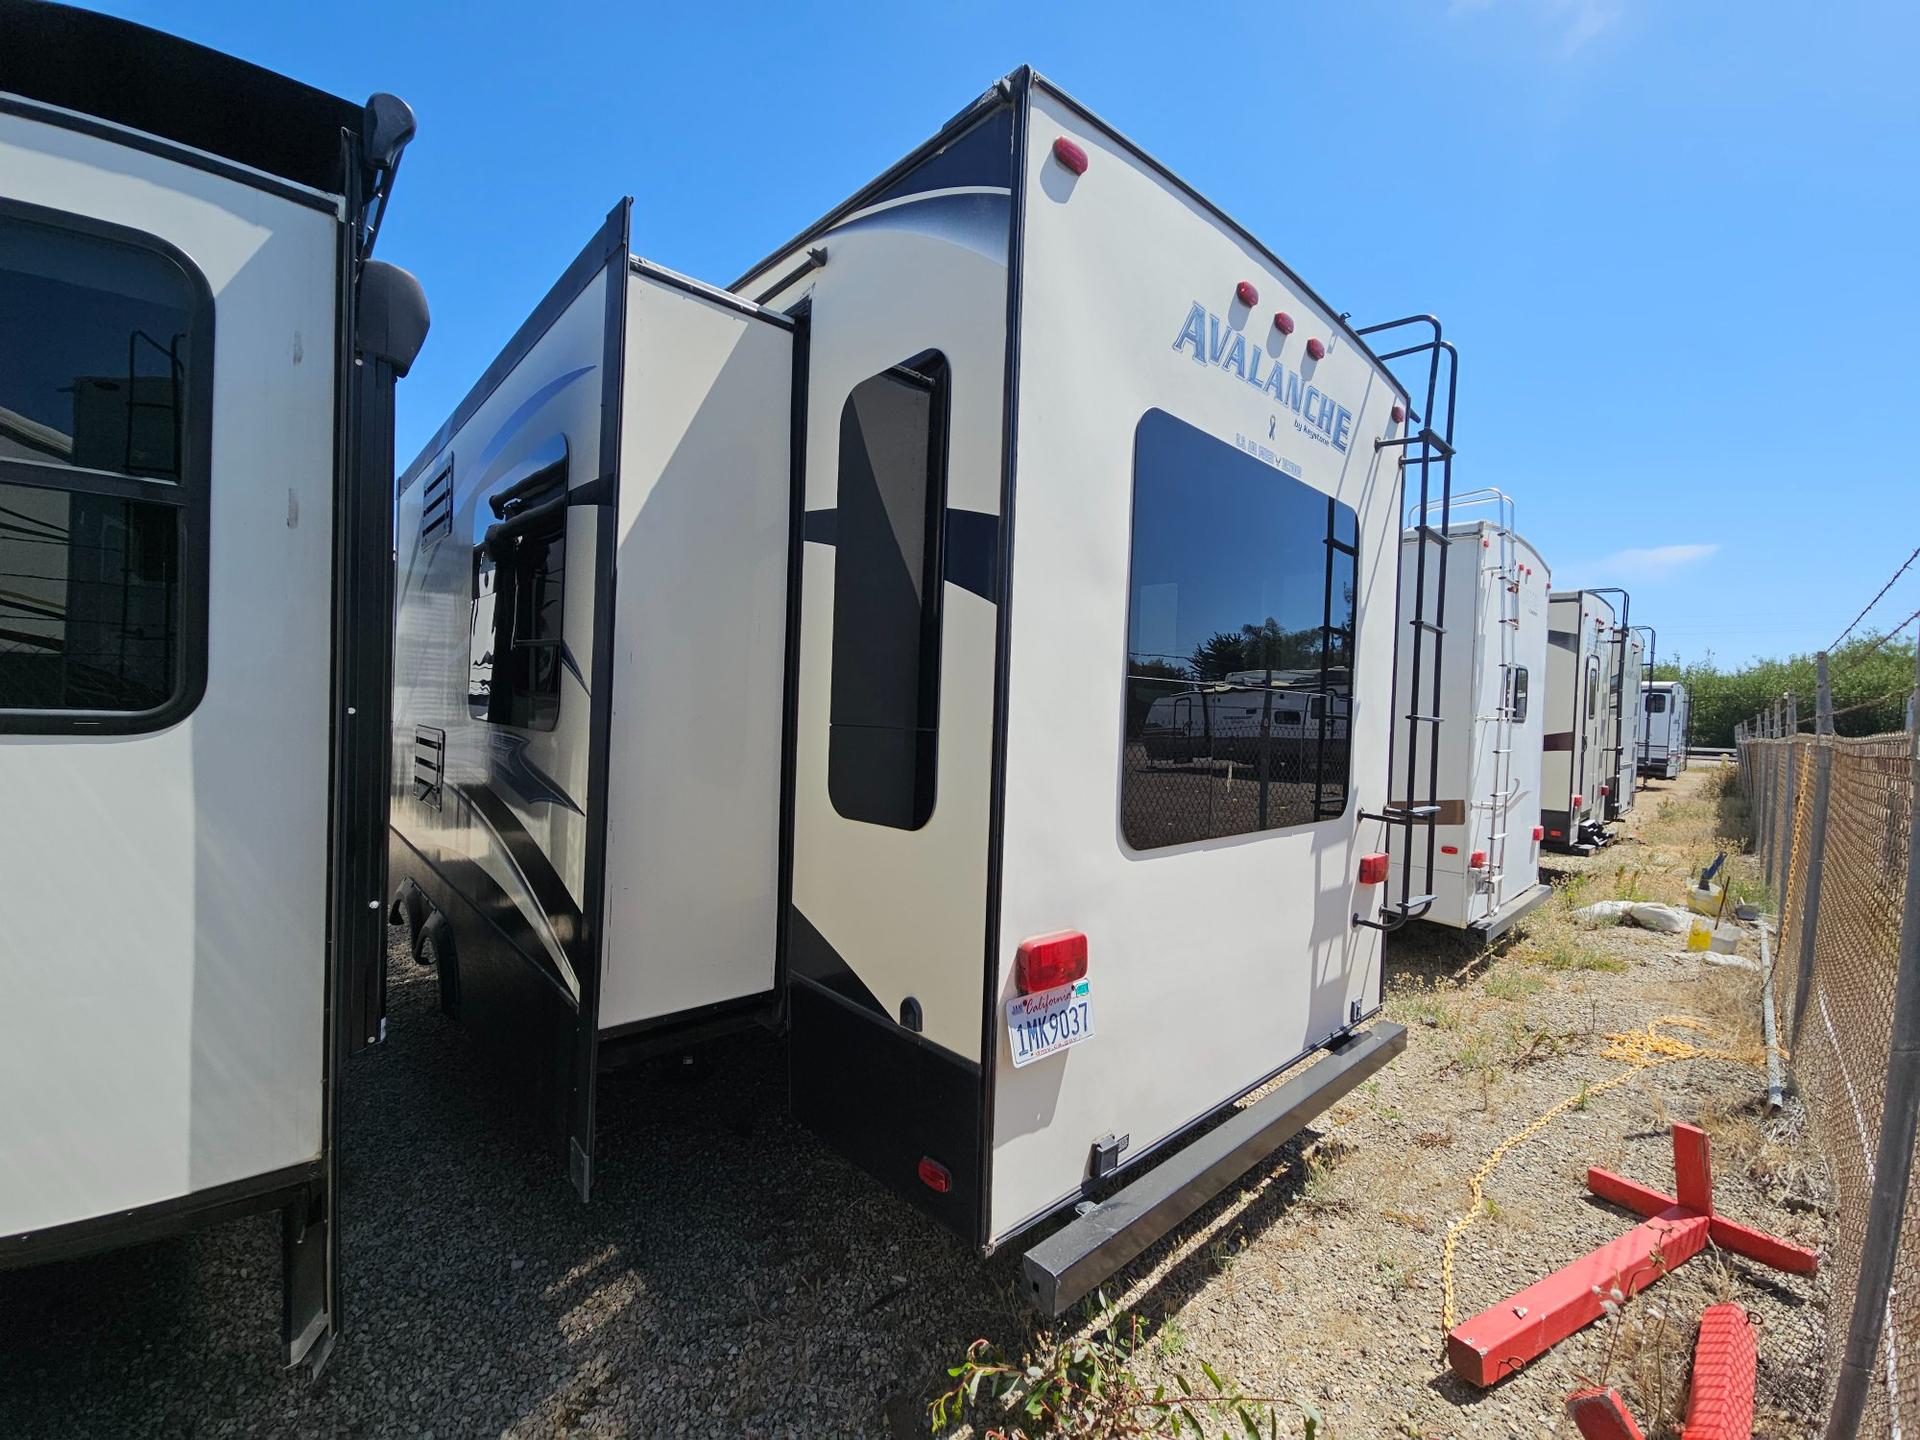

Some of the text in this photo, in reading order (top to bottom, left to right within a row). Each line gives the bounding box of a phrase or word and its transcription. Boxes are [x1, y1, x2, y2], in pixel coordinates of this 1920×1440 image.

[1172, 300, 1353, 455] AVALANCHE
[1294, 420, 1330, 447] by Keystone
[1026, 992, 1072, 1015] California
[1016, 1002, 1088, 1057] 1MK9037
